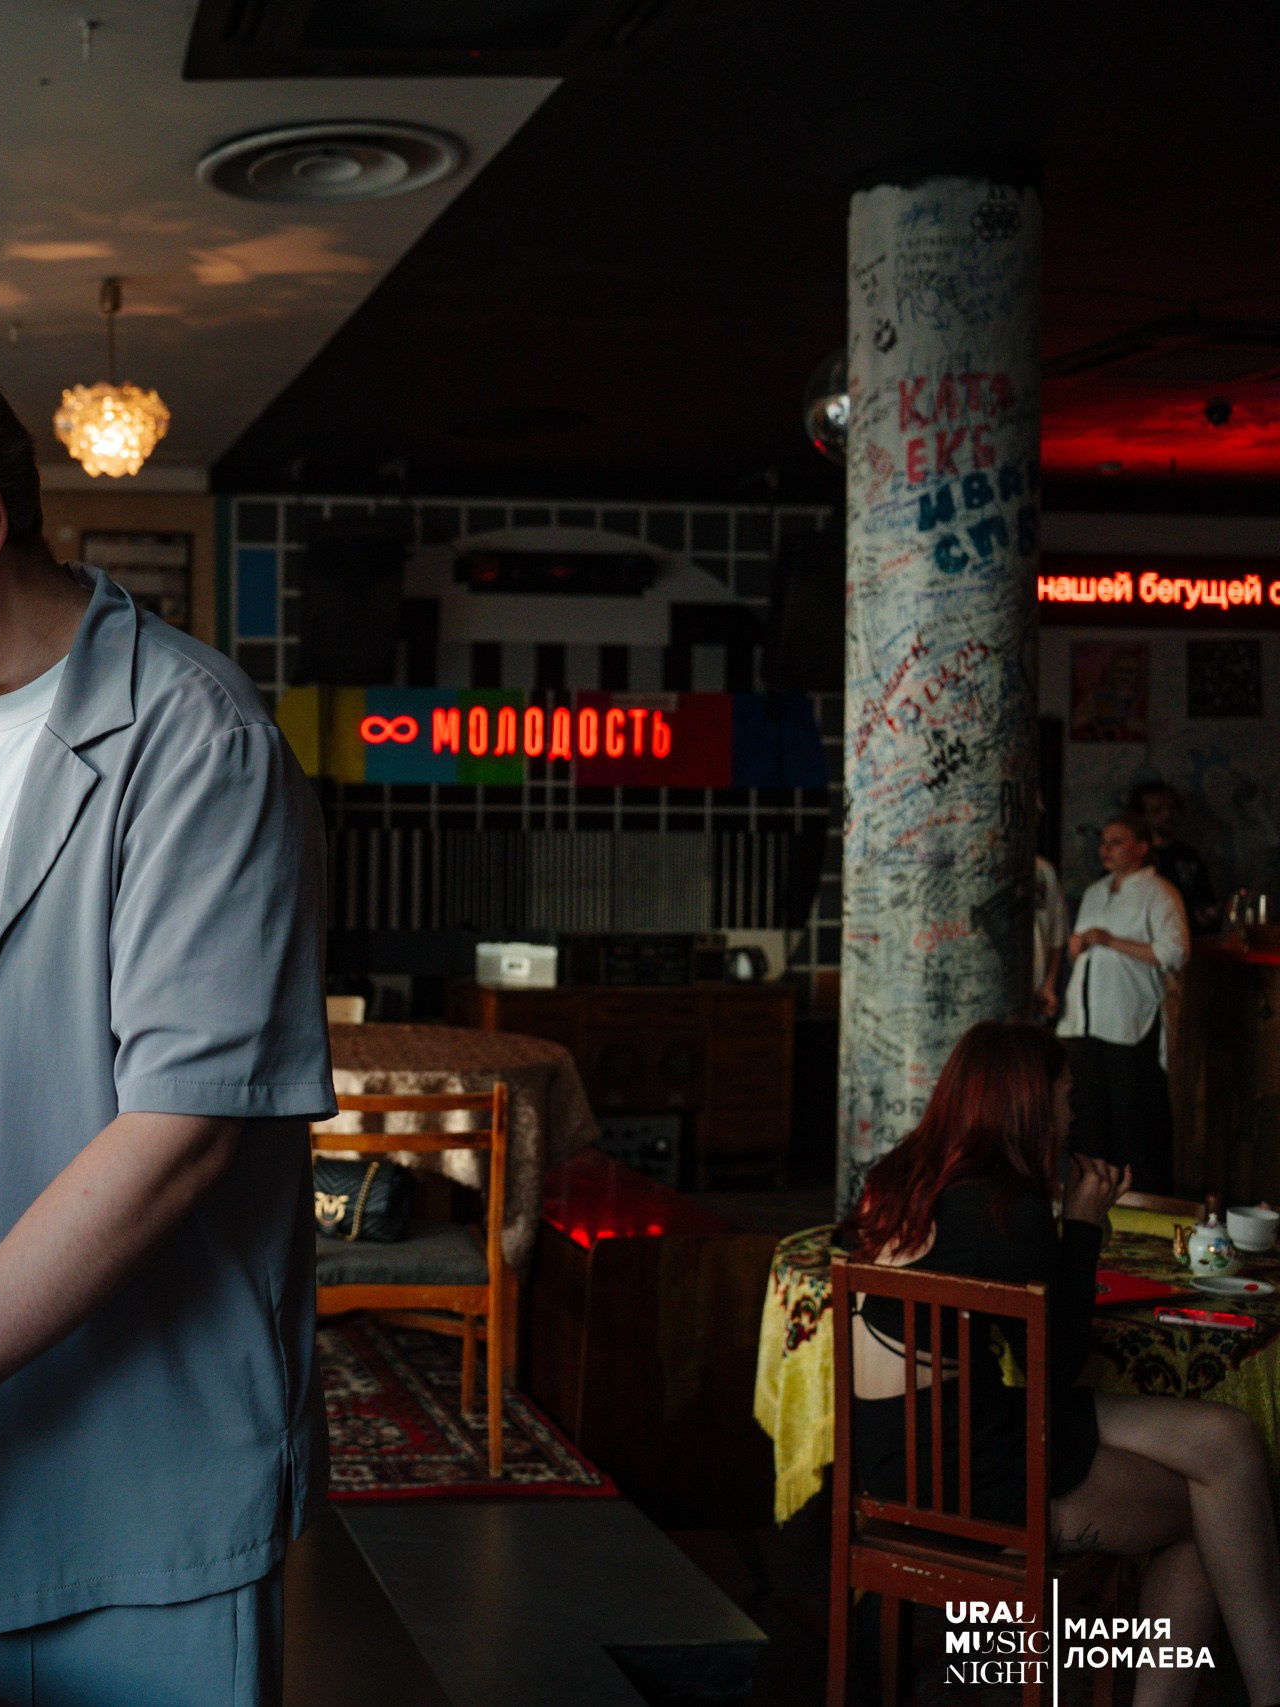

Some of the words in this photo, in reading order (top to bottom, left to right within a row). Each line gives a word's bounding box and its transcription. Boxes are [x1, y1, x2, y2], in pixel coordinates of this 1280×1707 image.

[897, 371, 1016, 432] КАТЯ
[906, 424, 996, 484] ЕКБ
[934, 505, 1037, 574] СПБ
[1037, 572, 1133, 602] нашей
[1139, 572, 1262, 610] бегущей
[431, 705, 671, 761] МОЛОДОСТЬ
